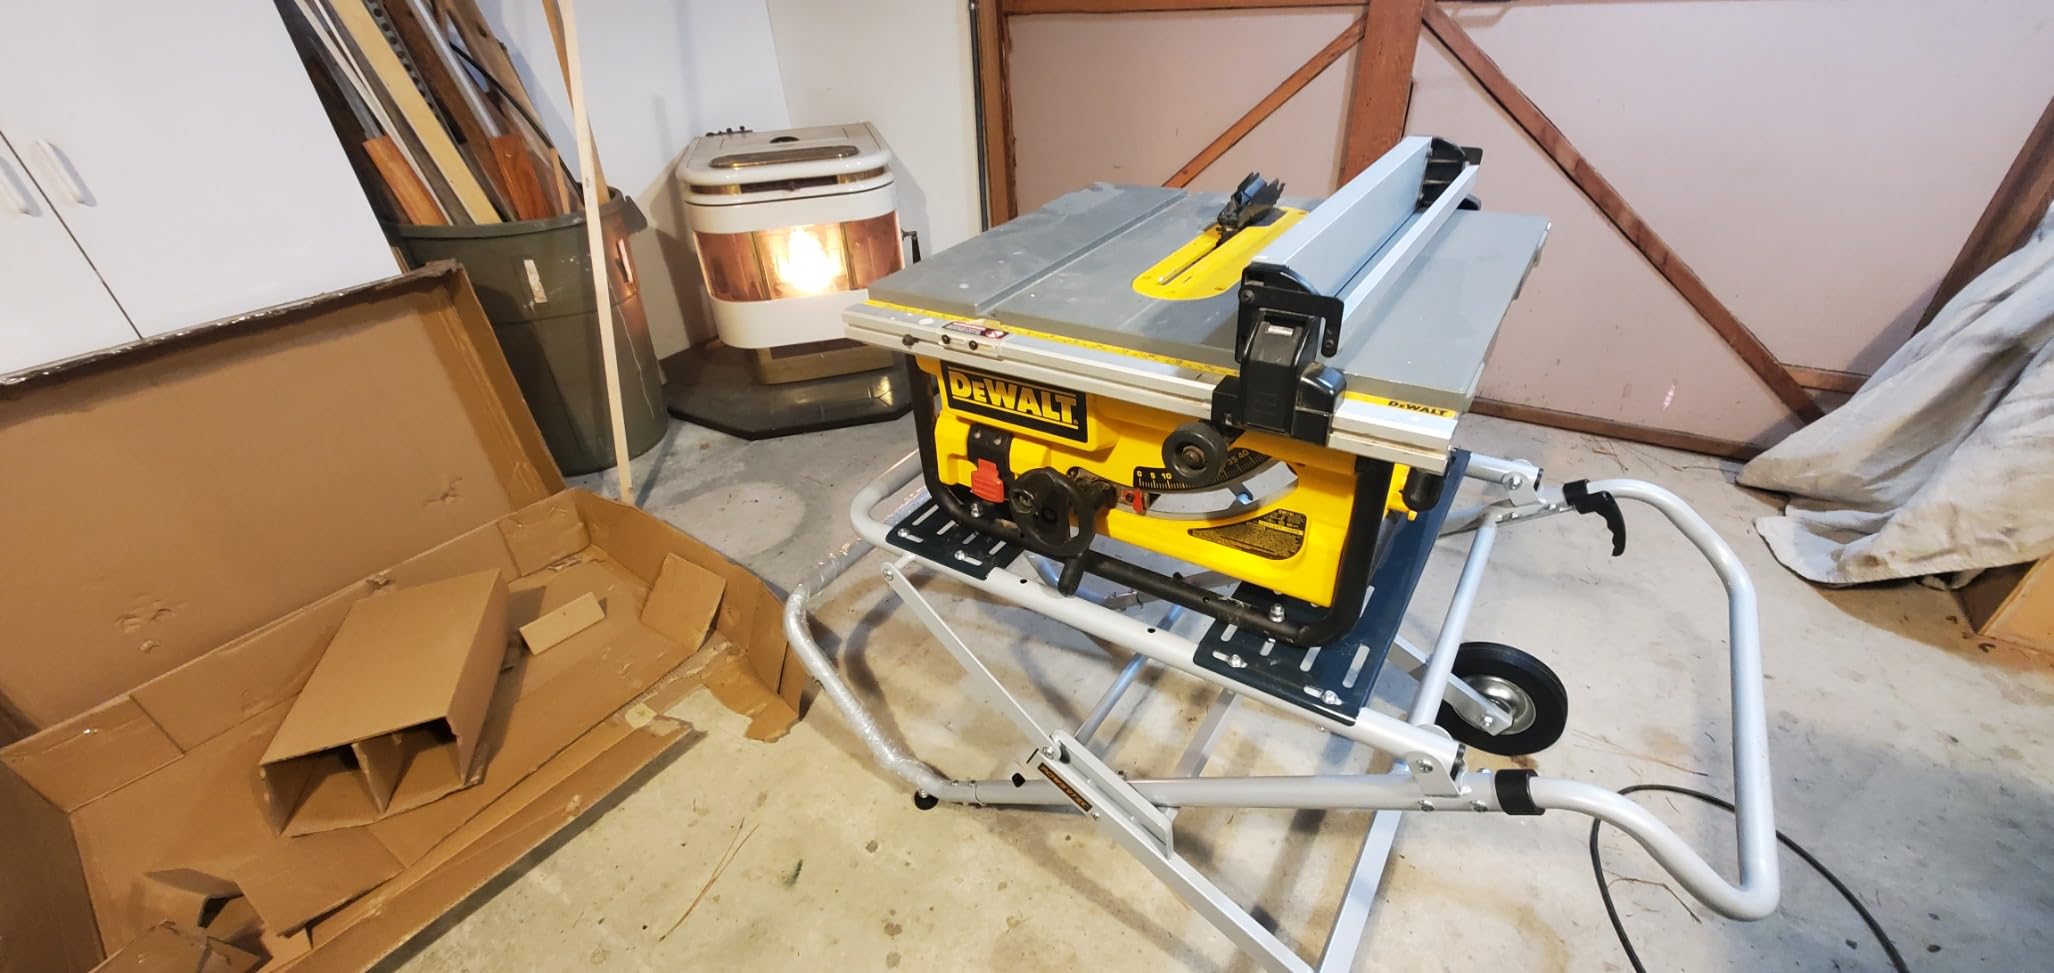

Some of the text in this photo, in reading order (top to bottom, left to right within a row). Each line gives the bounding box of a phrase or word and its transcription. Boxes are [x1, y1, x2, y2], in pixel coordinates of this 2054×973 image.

[948, 370, 1077, 424] DEWALT
[1388, 400, 1449, 417] DEWALT
[1136, 470, 1143, 478] 0
[1161, 472, 1173, 480] 10
[1238, 449, 1249, 459] 40
